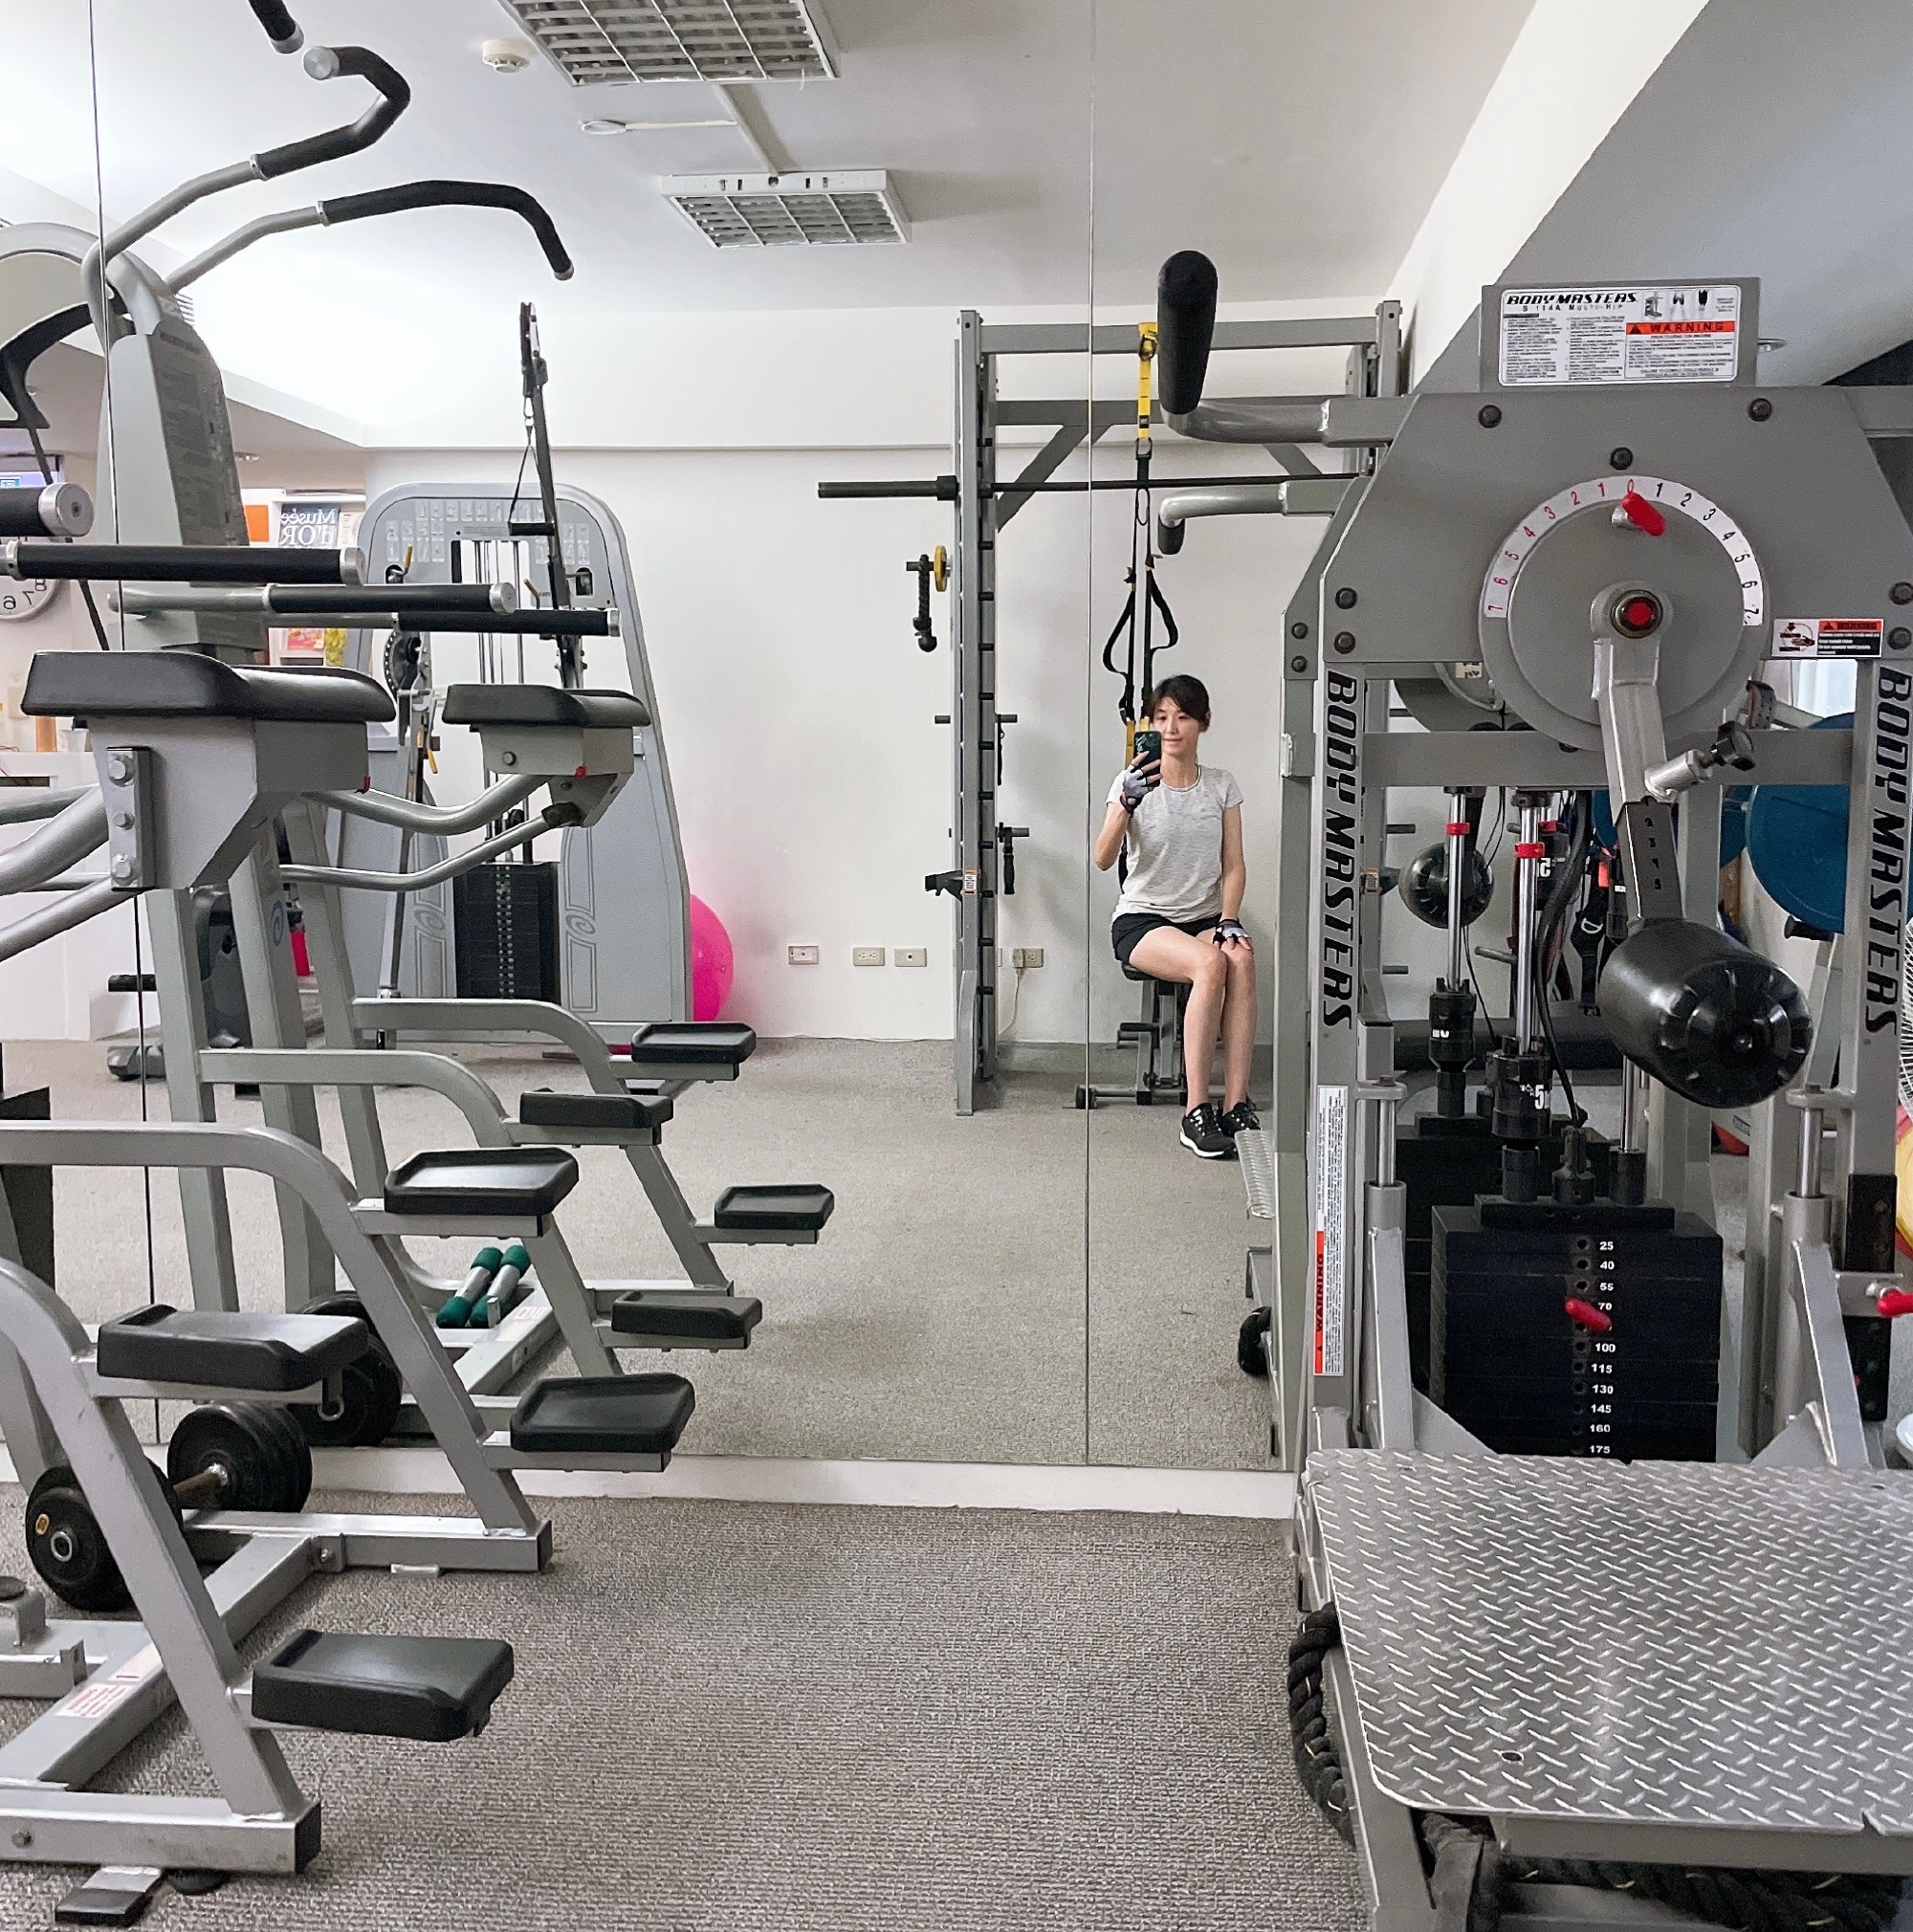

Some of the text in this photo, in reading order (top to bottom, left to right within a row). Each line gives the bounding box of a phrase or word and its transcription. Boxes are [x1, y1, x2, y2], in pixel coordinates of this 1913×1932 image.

[1651, 321, 1725, 333] WARNING
[1597, 482, 1606, 496] 1
[1627, 479, 1635, 494] 0
[1657, 482, 1663, 497] 1
[1571, 491, 1580, 506] 2
[1680, 493, 1692, 508] 2
[1545, 506, 1556, 520] 3
[1703, 508, 1716, 521] 3
[1523, 525, 1536, 538] 4
[1722, 531, 1736, 541] 4
[1505, 550, 1519, 560] 5
[1734, 553, 1750, 562] 5
[1493, 576, 1509, 586] 6
[1742, 581, 1758, 590] 6
[1487, 604, 1504, 612] 7
[1323, 808, 1356, 1030] MASTERS
[1864, 808, 1905, 1036] MASTERS
[1599, 1241, 1614, 1251] 25
[1600, 1261, 1615, 1270] 40
[1600, 1282, 1615, 1291] 55
[1598, 1302, 1613, 1311] 70
[1594, 1343, 1616, 1353] 100
[1591, 1363, 1613, 1373] 115
[1593, 1384, 1614, 1394] 130
[1591, 1404, 1612, 1414] 145
[1590, 1424, 1611, 1433] 160
[1590, 1444, 1611, 1454] 175
